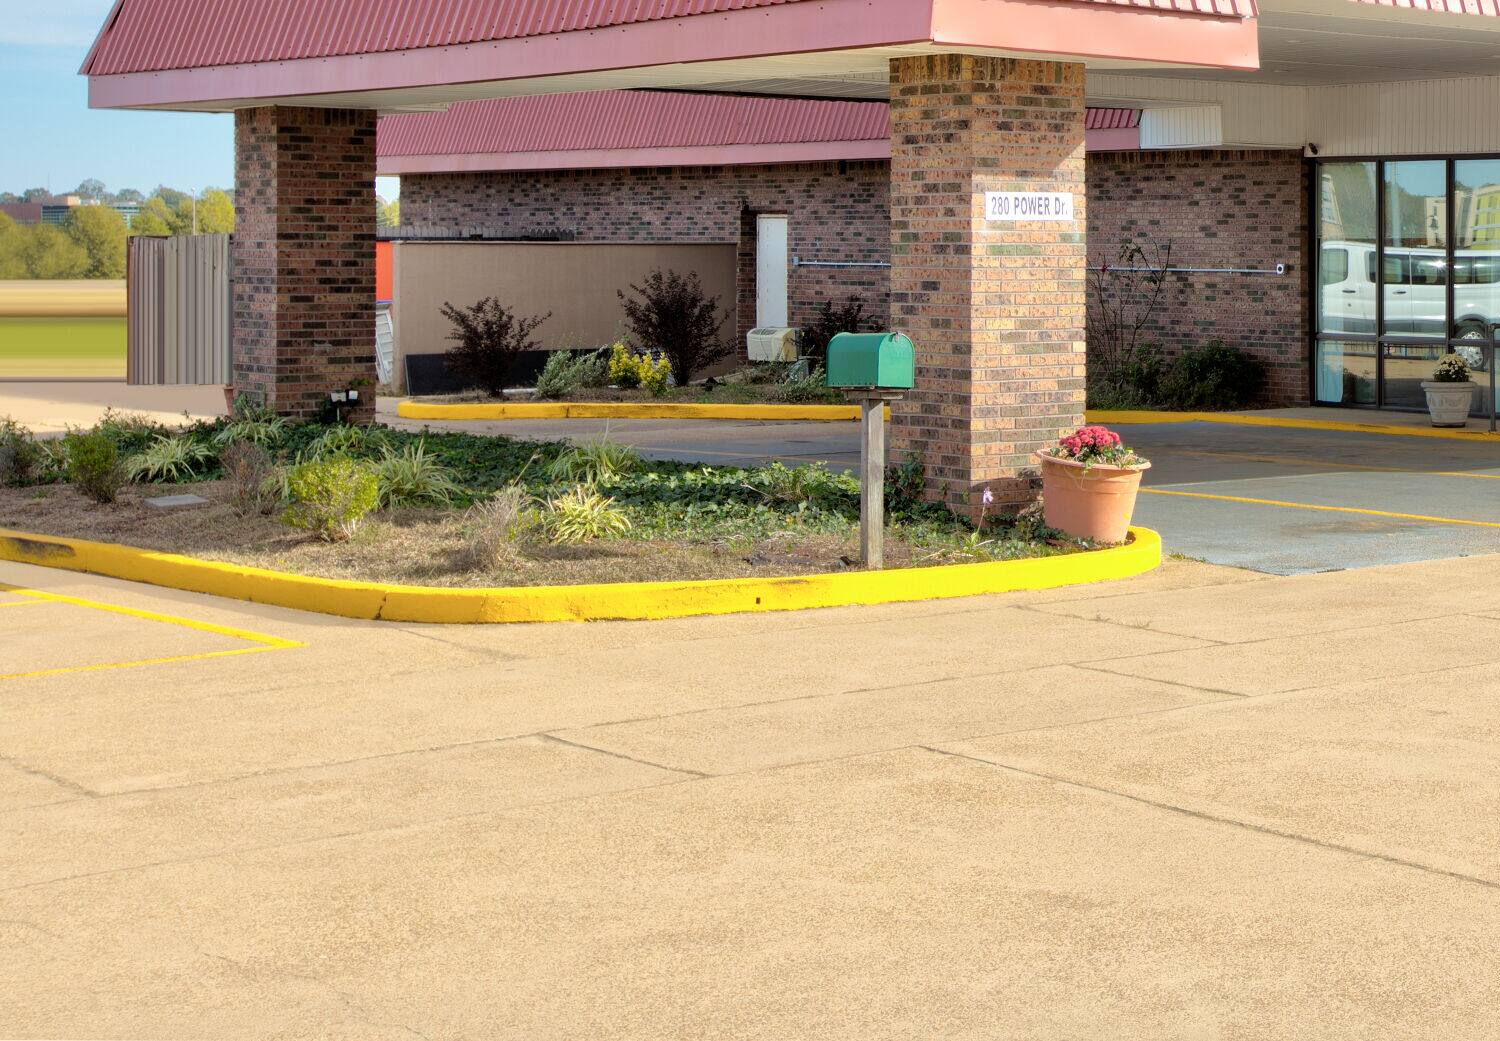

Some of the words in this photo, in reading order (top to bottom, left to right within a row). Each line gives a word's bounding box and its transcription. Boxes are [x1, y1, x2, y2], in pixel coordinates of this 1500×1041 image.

[991, 196, 1009, 215] 280
[1014, 196, 1050, 215] POWER
[1054, 197, 1068, 215] Dr.
